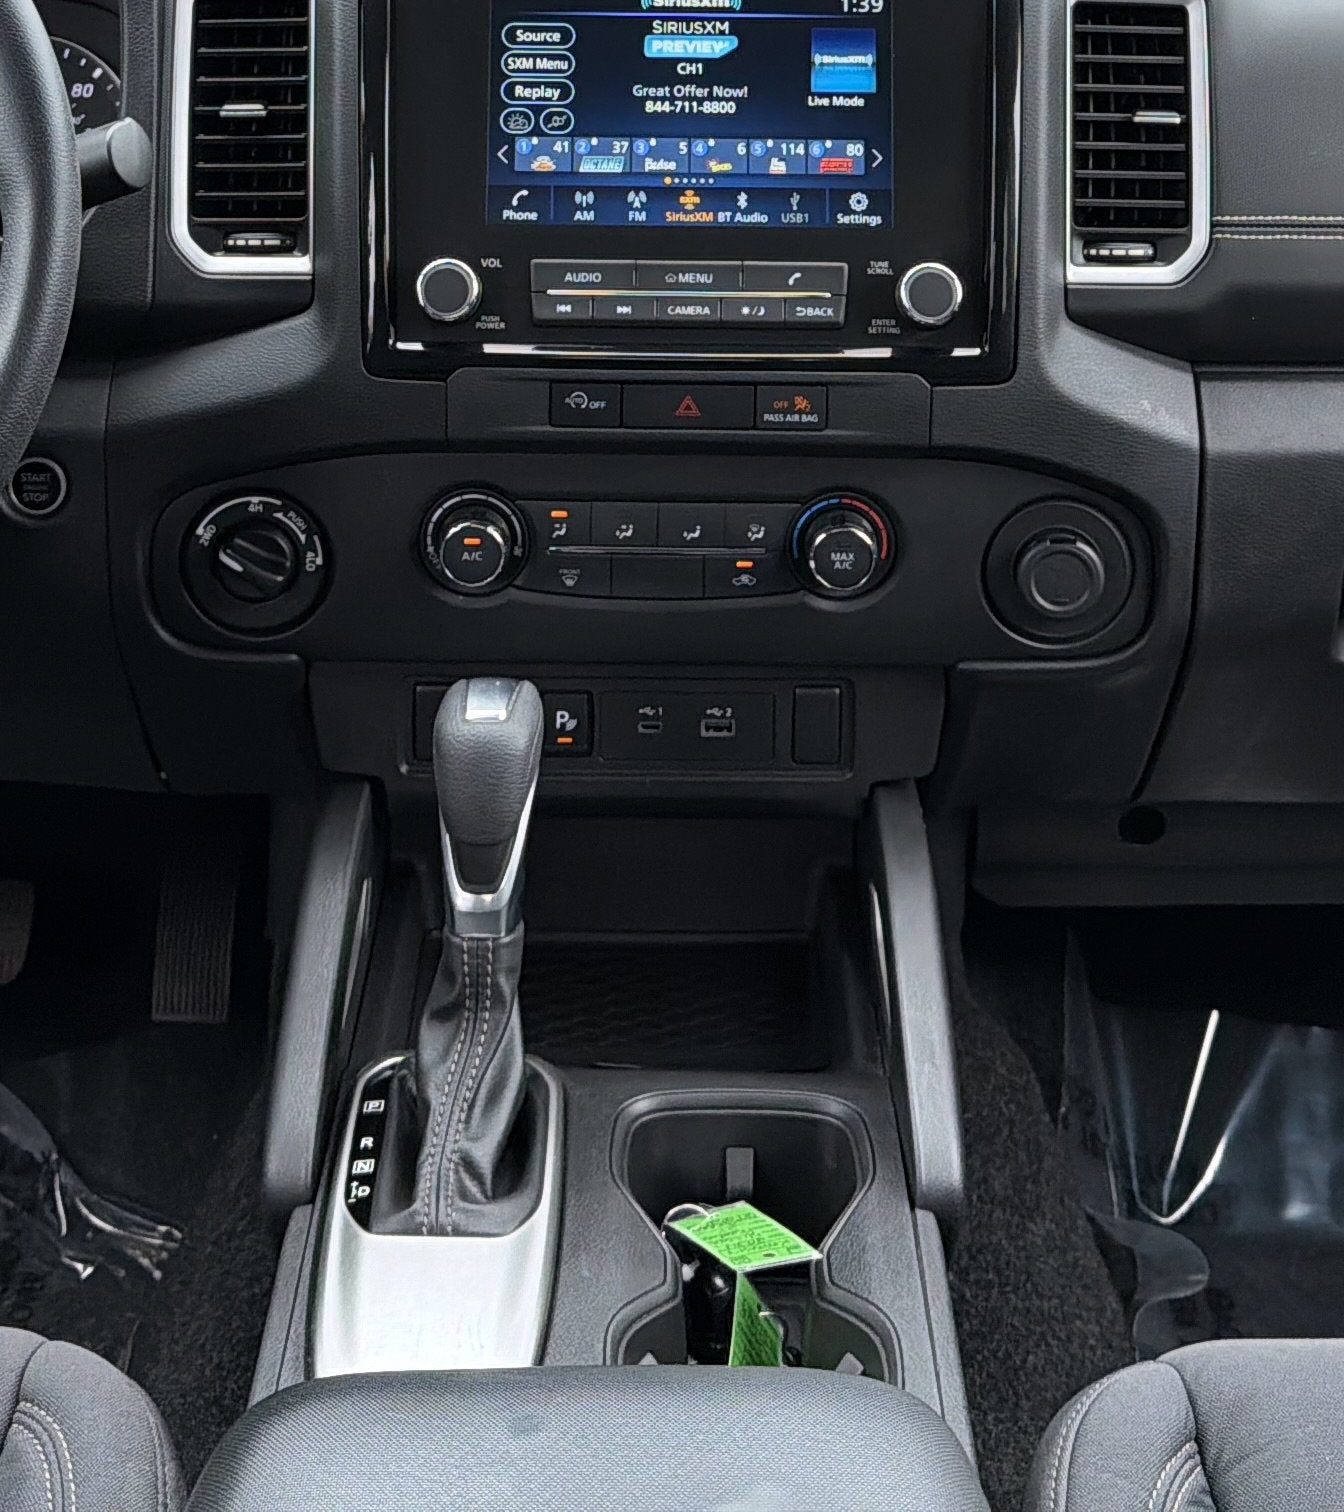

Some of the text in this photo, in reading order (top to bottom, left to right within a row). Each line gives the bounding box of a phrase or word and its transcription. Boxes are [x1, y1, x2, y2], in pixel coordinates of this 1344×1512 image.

[652, 20, 730, 35] SIRIUSXM
[516, 29, 561, 42] Source
[652, 40, 730, 54] PREVIEW
[507, 57, 569, 70] SXM Menu
[676, 63, 704, 75] CH1
[71, 83, 94, 98] 80
[514, 85, 561, 100] Replay
[632, 84, 749, 98] Great Offer Now!
[644, 101, 737, 114] 844-711-8800
[807, 96, 865, 107] Live Mode
[552, 140, 569, 153] 41
[612, 141, 629, 154] 37
[679, 141, 688, 155] 5
[737, 142, 747, 155] 6
[781, 143, 805, 156] 114
[846, 143, 864, 157] 80
[582, 158, 622, 170] OCTANE
[502, 209, 538, 221] Phone
[574, 210, 595, 221] AM
[628, 210, 647, 222] FM
[665, 211, 714, 222] SiriusXM
[717, 211, 769, 223] BT Audio
[781, 212, 809, 224] USB1
[836, 213, 883, 227] Settings
[480, 257, 503, 268] VOL
[869, 260, 890, 268] TUNE
[564, 271, 602, 283] AUDIO
[866, 267, 894, 276] SCROLL
[678, 272, 714, 284] MENU
[667, 305, 711, 316] CAMERA
[806, 306, 834, 317] BACK
[475, 321, 506, 330] POWER
[871, 318, 897, 327] ENTER
[867, 326, 901, 335] SETTING
[589, 400, 606, 410] OFF
[772, 400, 789, 410] OFF
[763, 413, 819, 423] PASS AIR BAG
[20, 472, 52, 482] START
[22, 492, 49, 502] STOP
[248, 503, 264, 513] 4H
[286, 510, 308, 532] PUSH
[198, 523, 217, 547] 2WD
[305, 550, 317, 572] 4LO
[461, 551, 483, 562] A/C
[830, 551, 855, 561] MAX
[833, 561, 853, 570] A/C
[555, 710, 570, 730] P
[359, 1136, 374, 1150] R
[357, 1185, 371, 1199] D
